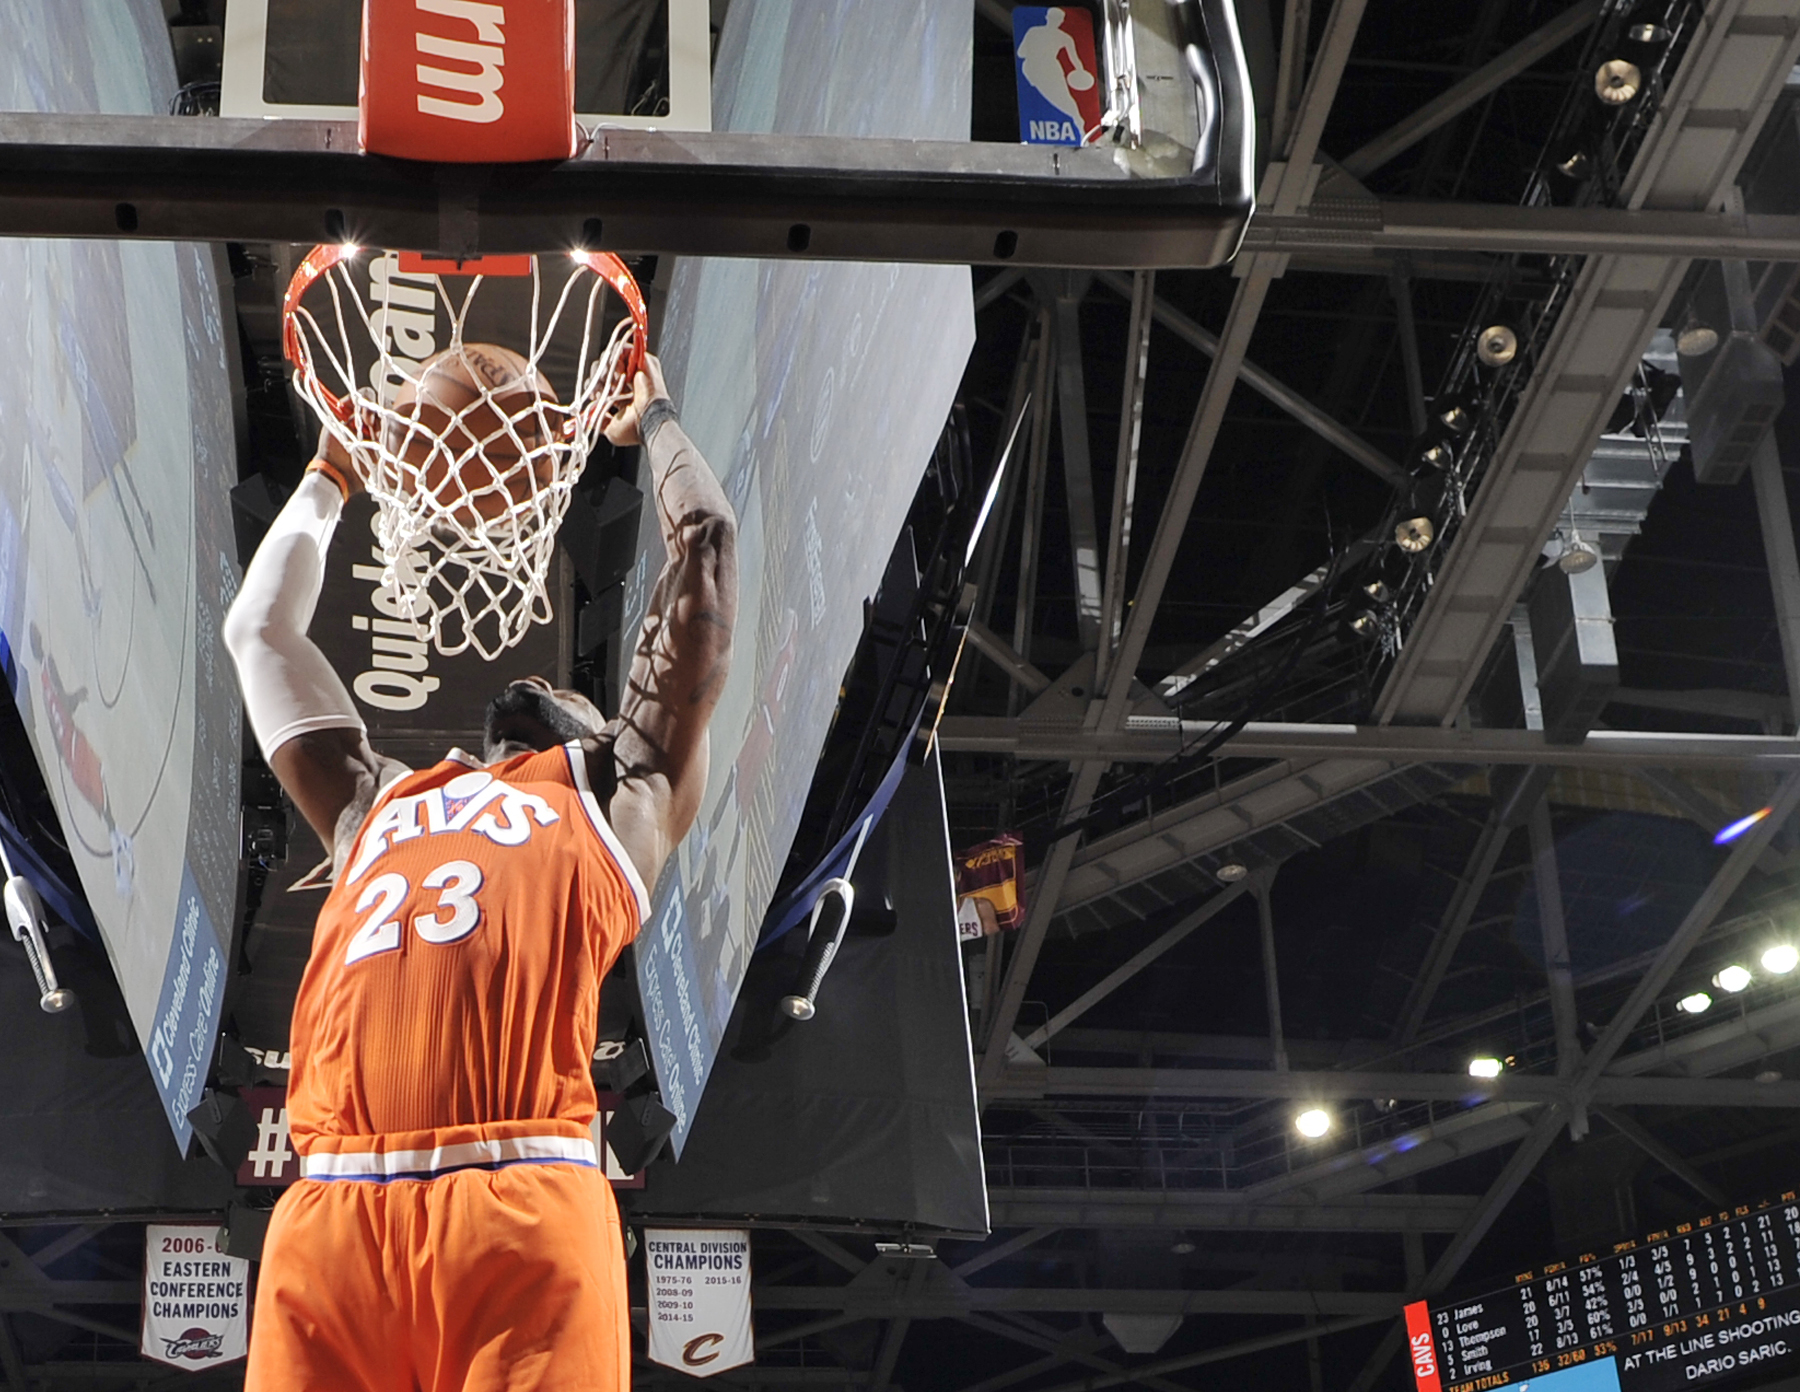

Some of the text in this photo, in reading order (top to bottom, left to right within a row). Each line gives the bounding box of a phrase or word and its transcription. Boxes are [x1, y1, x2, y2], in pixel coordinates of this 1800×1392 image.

[1029, 120, 1076, 141] NBA
[346, 772, 560, 886] AVS
[345, 860, 484, 966] 23
[162, 1238, 224, 1254] 2006-
[649, 1241, 747, 1254] CENTRAL DIVISION
[163, 1261, 231, 1278] EASTERN
[654, 1254, 743, 1270] CHAMPIONS
[150, 1281, 243, 1298] CONFERENCE
[153, 1301, 239, 1319] CHAMPIONS
[1437, 1304, 1484, 1326] 23 James
[1456, 1320, 1479, 1335] Love
[1458, 1326, 1507, 1348] Thompson
[1624, 1309, 1800, 1372] AT THE LINE SHOOTING
[1411, 1332, 1435, 1378] CAVS
[1685, 1340, 1792, 1380] DARIO SARIC.
[1475, 1371, 1510, 1391] TOTALS
